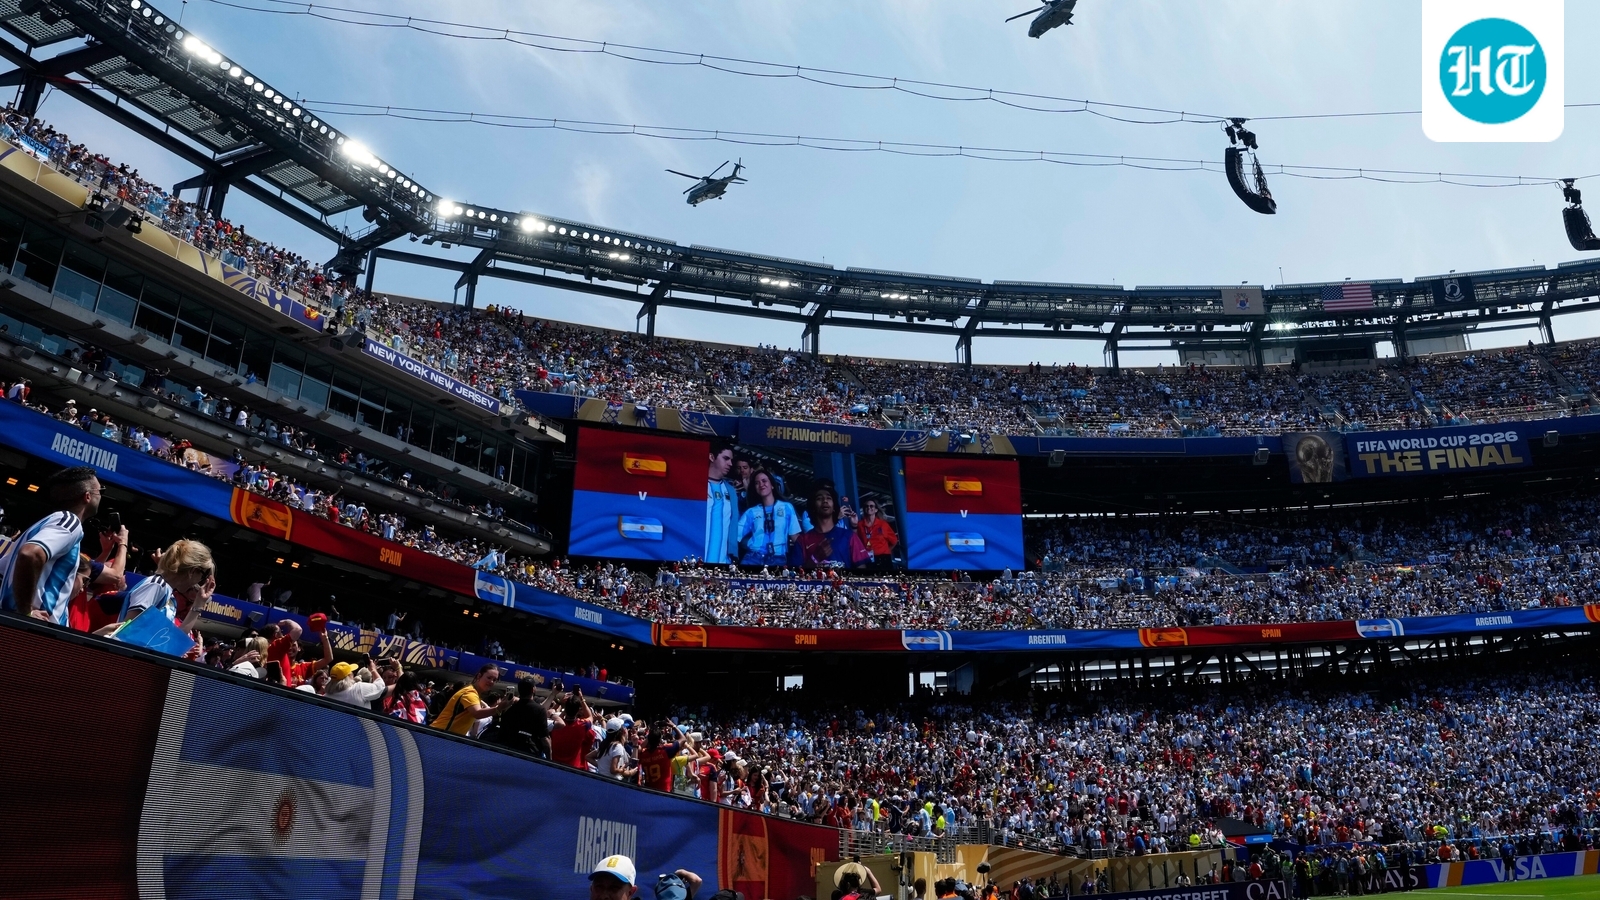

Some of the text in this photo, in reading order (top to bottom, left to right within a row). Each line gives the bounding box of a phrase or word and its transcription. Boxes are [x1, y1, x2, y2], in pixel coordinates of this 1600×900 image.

[20, 133, 48, 155] ENDOZA
[368, 342, 494, 409] NEW YORK NEW JERSEY
[766, 425, 852, 447] #FIFAWorldCup
[1356, 430, 1519, 453] FIFA WORLD CUP 2026
[50, 432, 119, 473] ARGENTINA
[1358, 443, 1524, 475] THE FINAL
[379, 547, 403, 567] SPAIN
[746, 582, 765, 591] FFA
[574, 606, 603, 625] ARGENTINA
[1474, 615, 1513, 627] ARGENTINA
[794, 634, 818, 645] SPAIN
[1028, 634, 1067, 645] ARGENTINA
[1261, 628, 1282, 638] SPAIN
[573, 815, 637, 875] ARGENTINA
